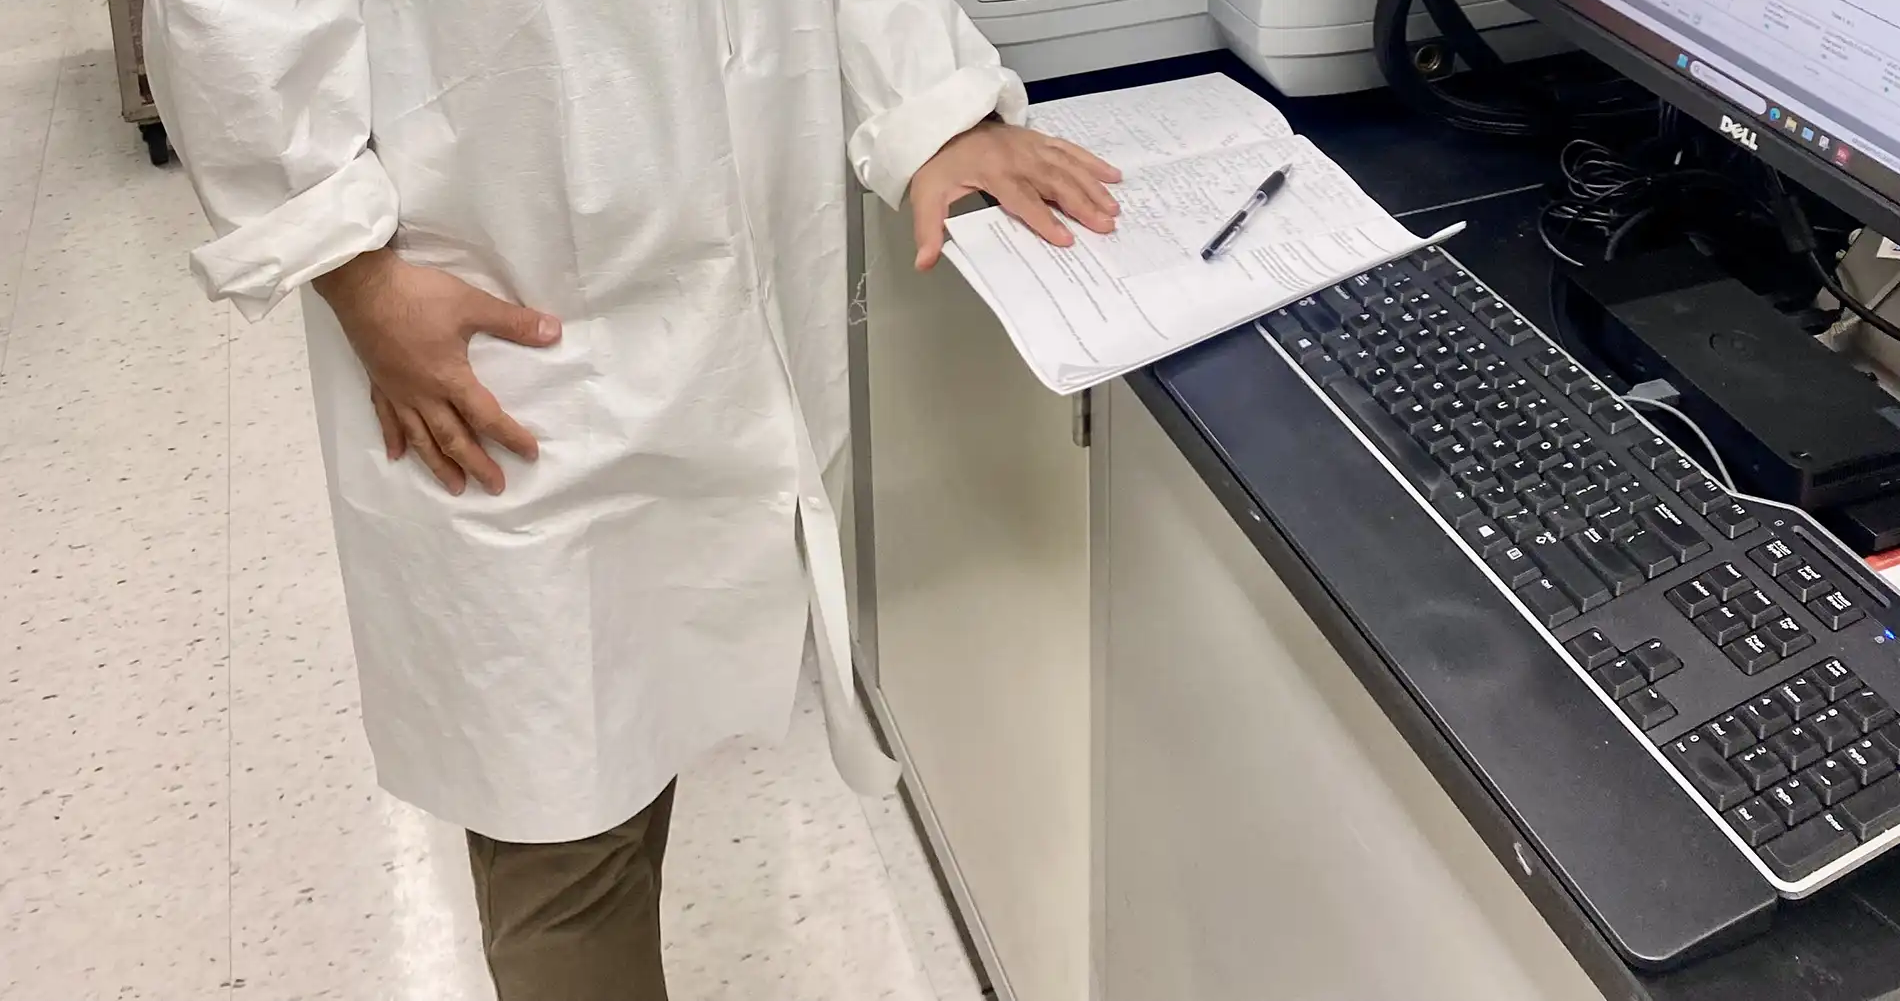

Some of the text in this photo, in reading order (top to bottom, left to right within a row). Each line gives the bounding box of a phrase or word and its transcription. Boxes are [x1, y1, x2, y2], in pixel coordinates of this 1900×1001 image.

[1720, 115, 1758, 150] DELL
[1402, 313, 1414, 321] W
[1358, 350, 1368, 358] X
[1433, 381, 1444, 389] G
[1478, 381, 1488, 389] Y
[1452, 400, 1463, 408] H
[1497, 401, 1508, 409] U
[1432, 423, 1443, 432] N
[1493, 439, 1504, 447] K
[1452, 444, 1464, 453] M
[1705, 481, 1717, 491] F11
[1692, 581, 1710, 596] Delete
[1754, 590, 1771, 605] Home
[1721, 607, 1734, 618] End
[1745, 637, 1763, 653] Down
[1751, 634, 1766, 648] Page
[1826, 663, 1841, 677] Lock
[1832, 660, 1848, 674] Num
[1828, 708, 1838, 716] 8
[1712, 722, 1727, 736] End
[1792, 727, 1802, 735] 5
[1689, 734, 1700, 742] 0
[1861, 740, 1872, 748] 9
[1756, 746, 1766, 755] 2
[1848, 748, 1867, 765] PgUp
[1789, 779, 1799, 787] 3
[1775, 787, 1793, 805] PgDn
[1738, 807, 1753, 821] Del
[1825, 813, 1844, 831] Enter
